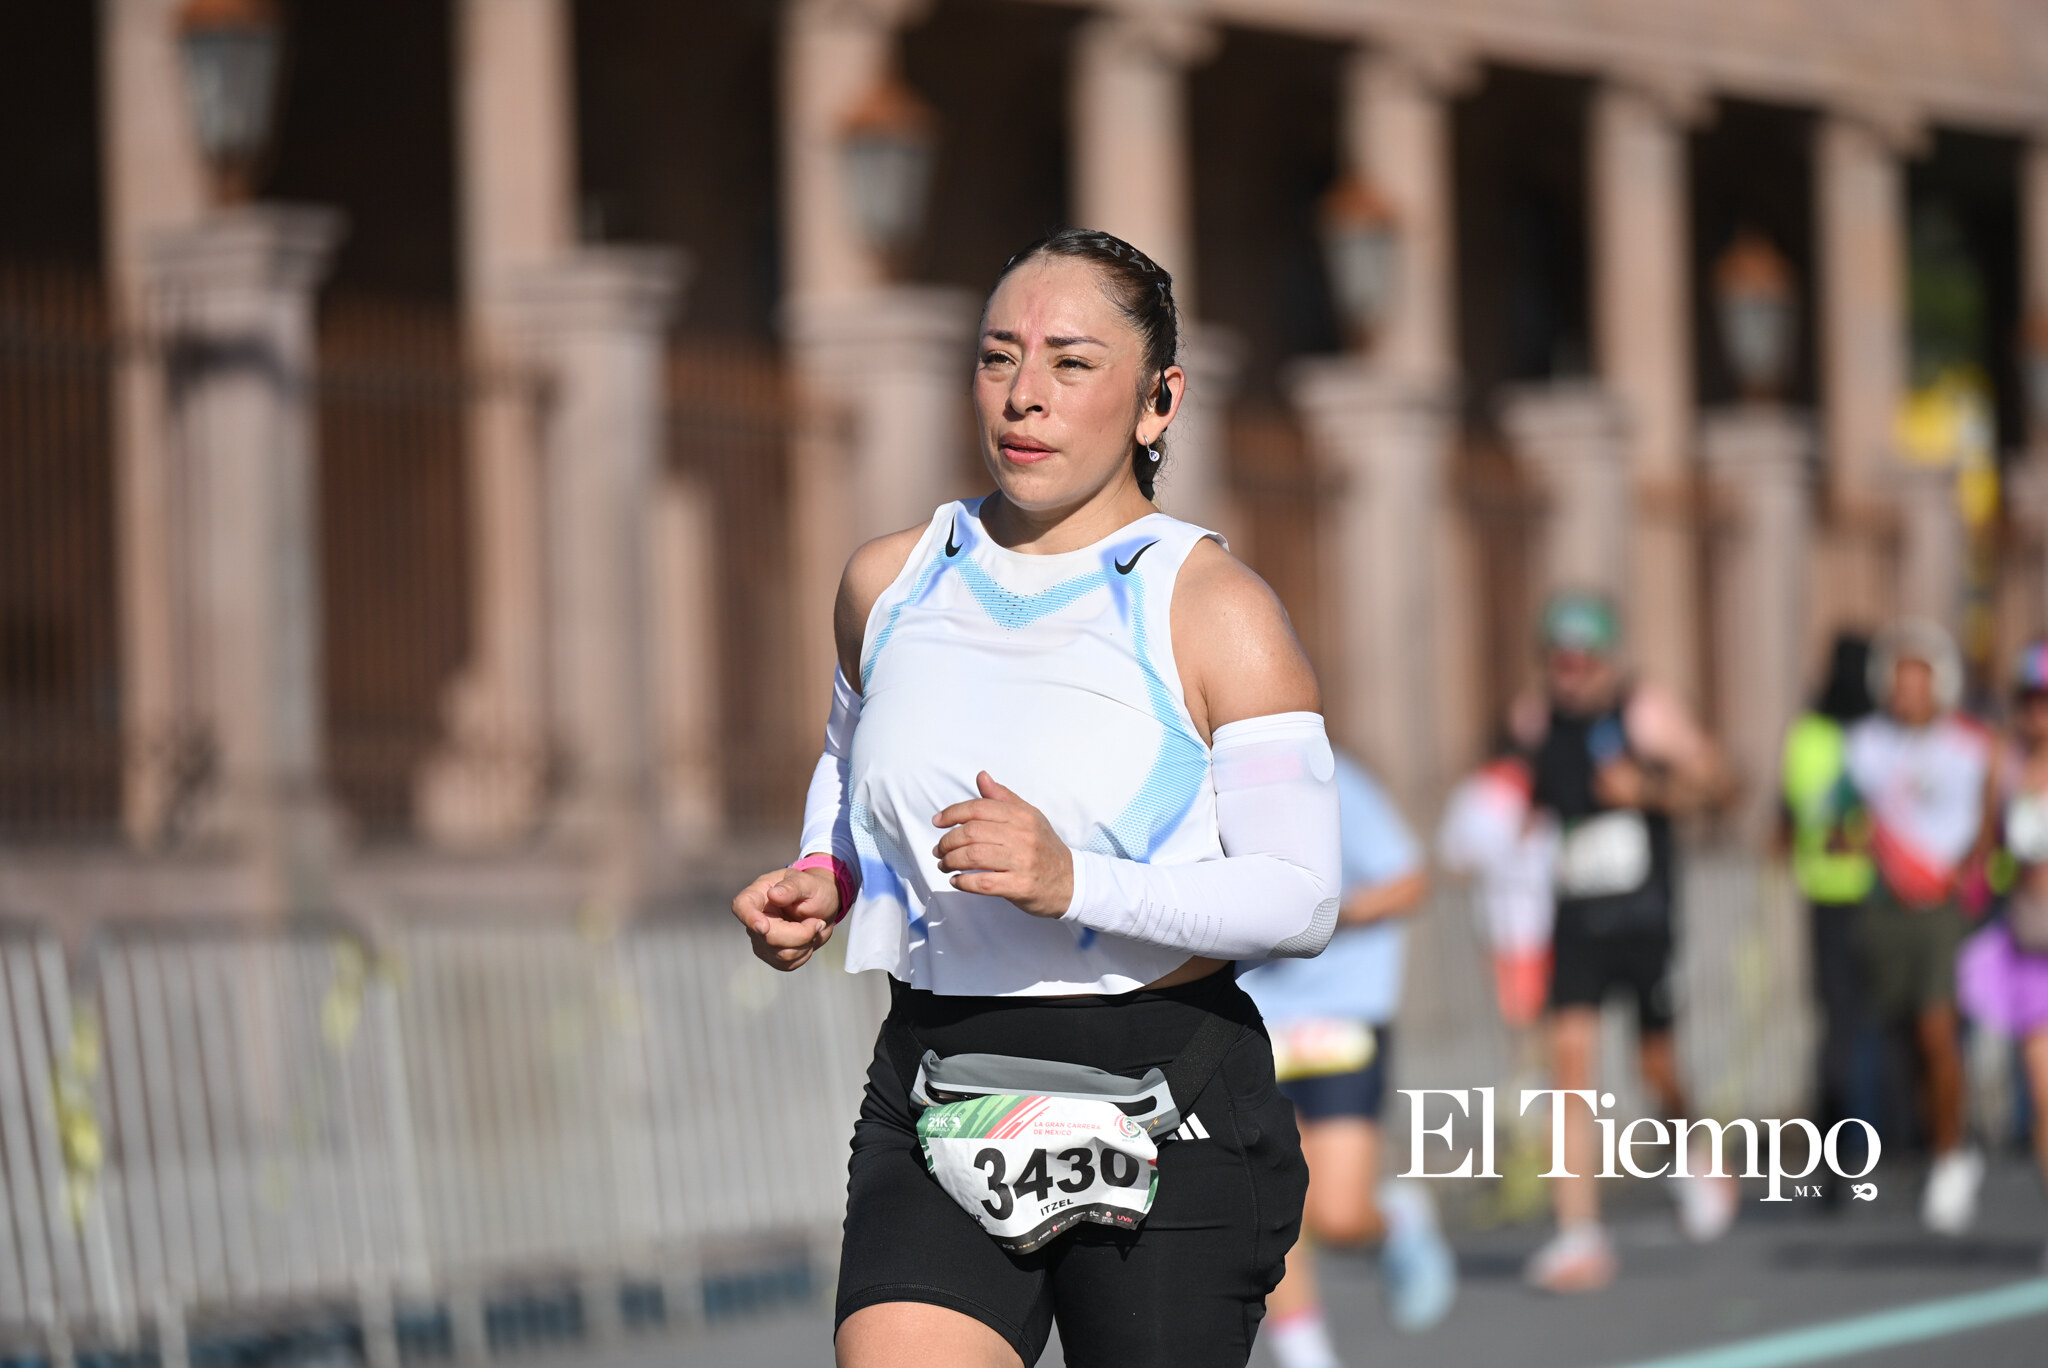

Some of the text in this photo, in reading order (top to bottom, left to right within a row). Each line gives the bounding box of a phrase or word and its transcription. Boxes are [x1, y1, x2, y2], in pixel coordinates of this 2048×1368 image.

[927, 1116, 949, 1128] 21K
[1045, 1121, 1065, 1129] GRAN
[1066, 1122, 1102, 1131] CARRERA
[973, 1147, 1140, 1221] 3430
[1040, 1198, 1074, 1217] ITZEL
